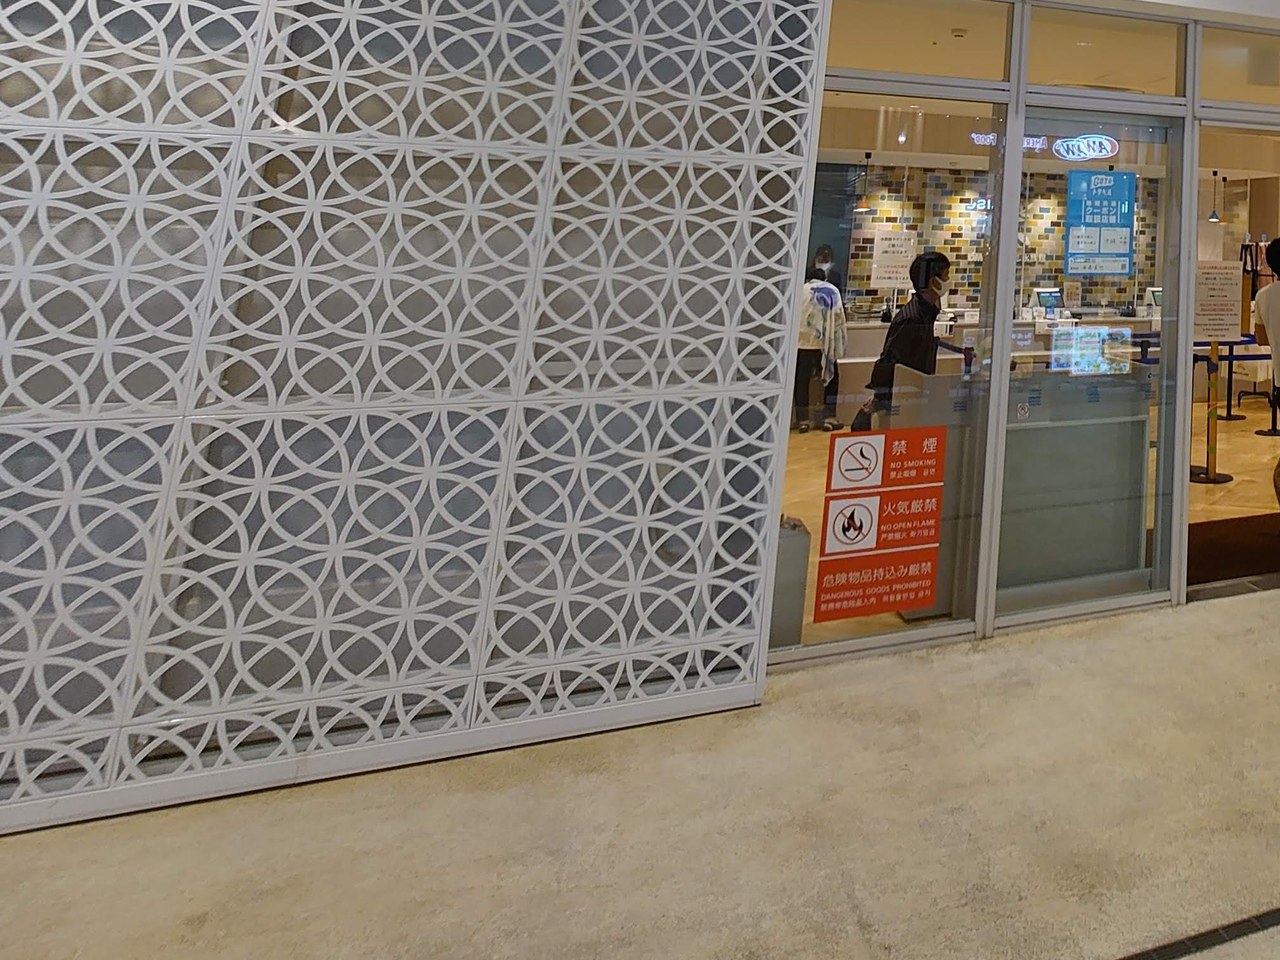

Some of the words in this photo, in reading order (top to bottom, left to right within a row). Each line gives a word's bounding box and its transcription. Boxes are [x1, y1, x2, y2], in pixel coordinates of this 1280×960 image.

[1086, 206, 1117, 215] クーポン
[890, 461, 901, 469] NO
[903, 458, 937, 468] SMOKING
[883, 498, 937, 517] 火気厳禁
[880, 523, 892, 532] NO
[892, 521, 912, 531] OPEN
[913, 518, 936, 529] FLAME
[822, 561, 932, 589] 危険物品持込み厳禁
[820, 588, 864, 602] DANGEROUS
[866, 585, 891, 596] GOODS
[892, 579, 932, 592] PROHIBITED
